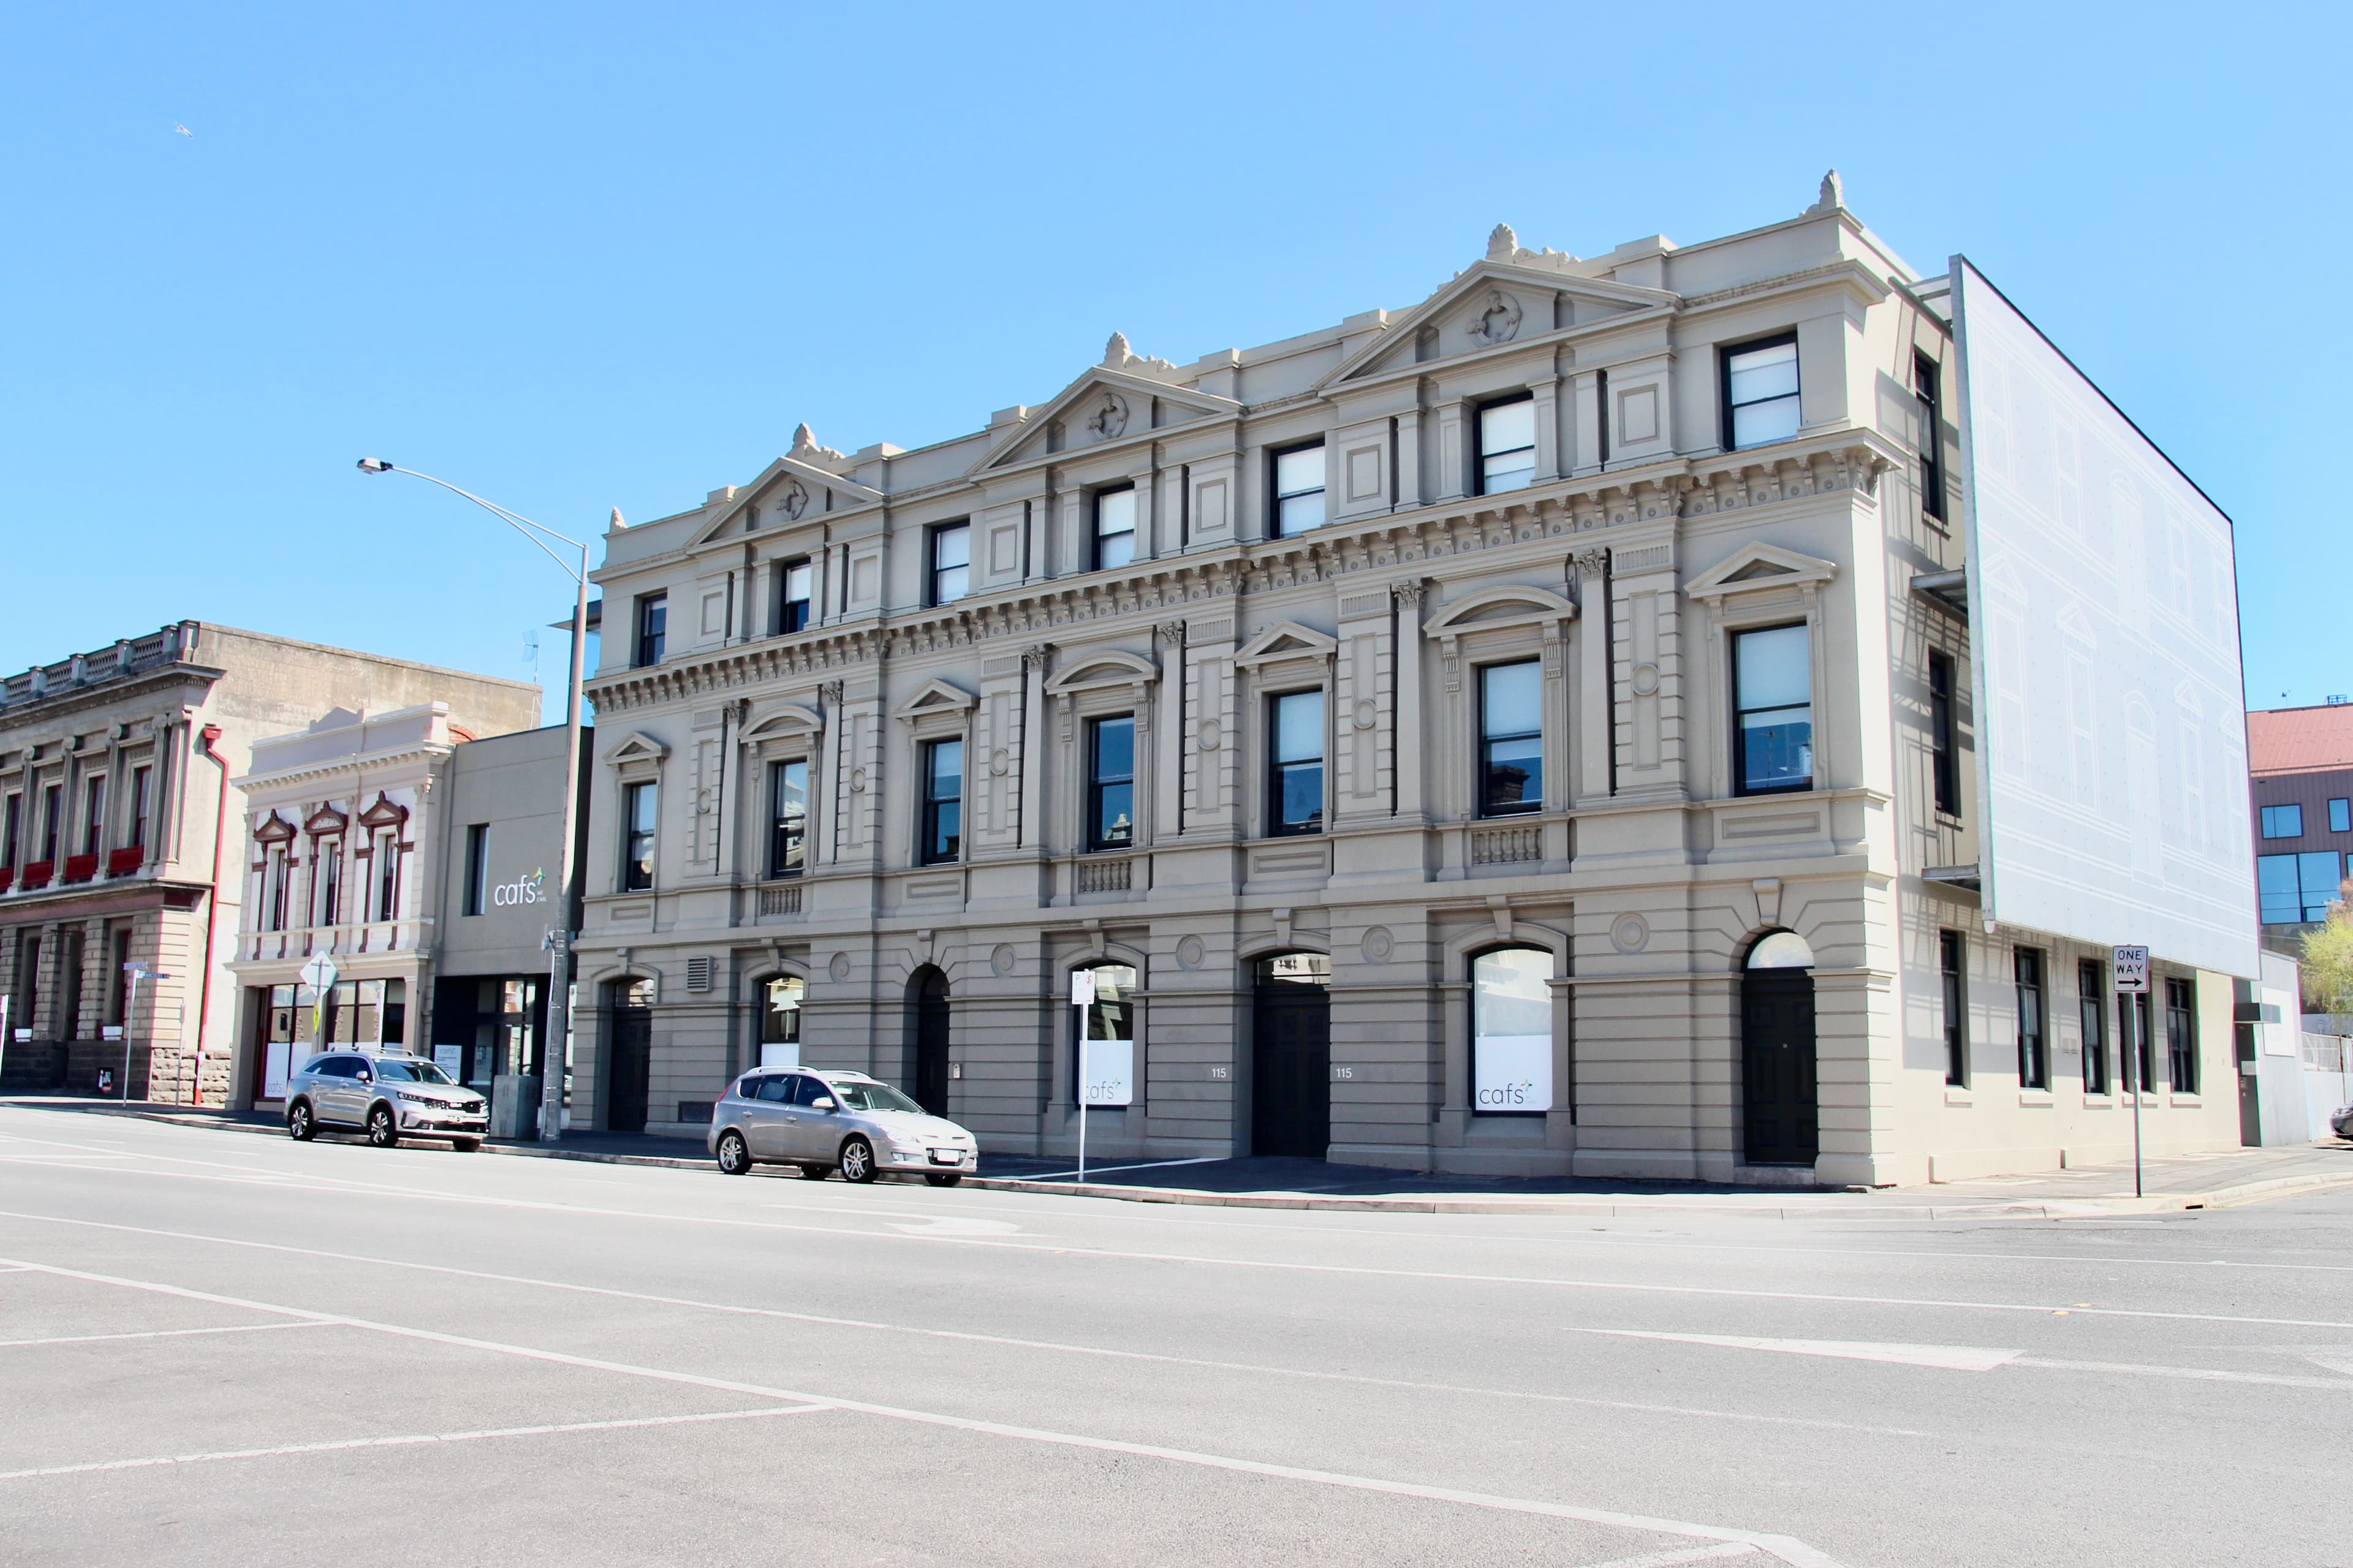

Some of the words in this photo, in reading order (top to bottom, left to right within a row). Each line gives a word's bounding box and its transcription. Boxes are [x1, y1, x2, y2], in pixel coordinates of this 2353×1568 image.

[494, 874, 536, 906] cafs
[2118, 950, 2142, 960] ONE
[2116, 964, 2143, 974] WAY
[1212, 1068, 1226, 1078] 115
[1336, 1068, 1352, 1078] 115
[267, 1080, 282, 1093] cafs
[1479, 1083, 1524, 1104] cafs
